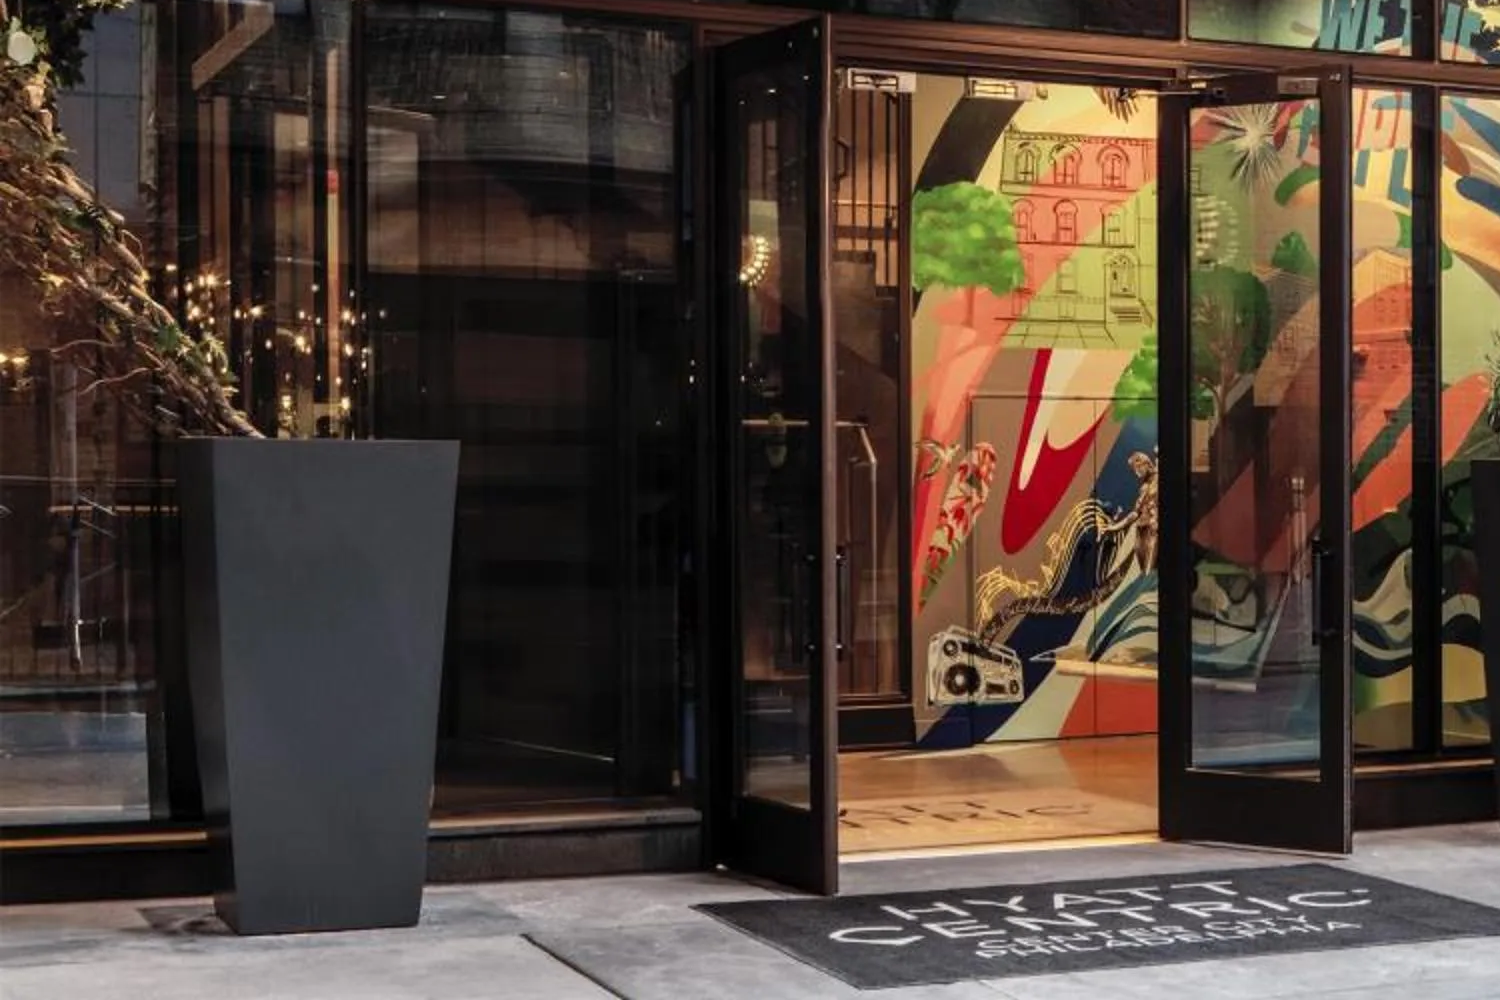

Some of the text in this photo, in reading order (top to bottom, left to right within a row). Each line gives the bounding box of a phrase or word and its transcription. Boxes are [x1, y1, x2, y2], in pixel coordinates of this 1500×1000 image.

[828, 889, 1372, 946] CENTRIC
[880, 881, 1239, 921] HYATT
[975, 921, 1363, 959] PHILADELPHIA
[978, 925, 1203, 949] CENTER
